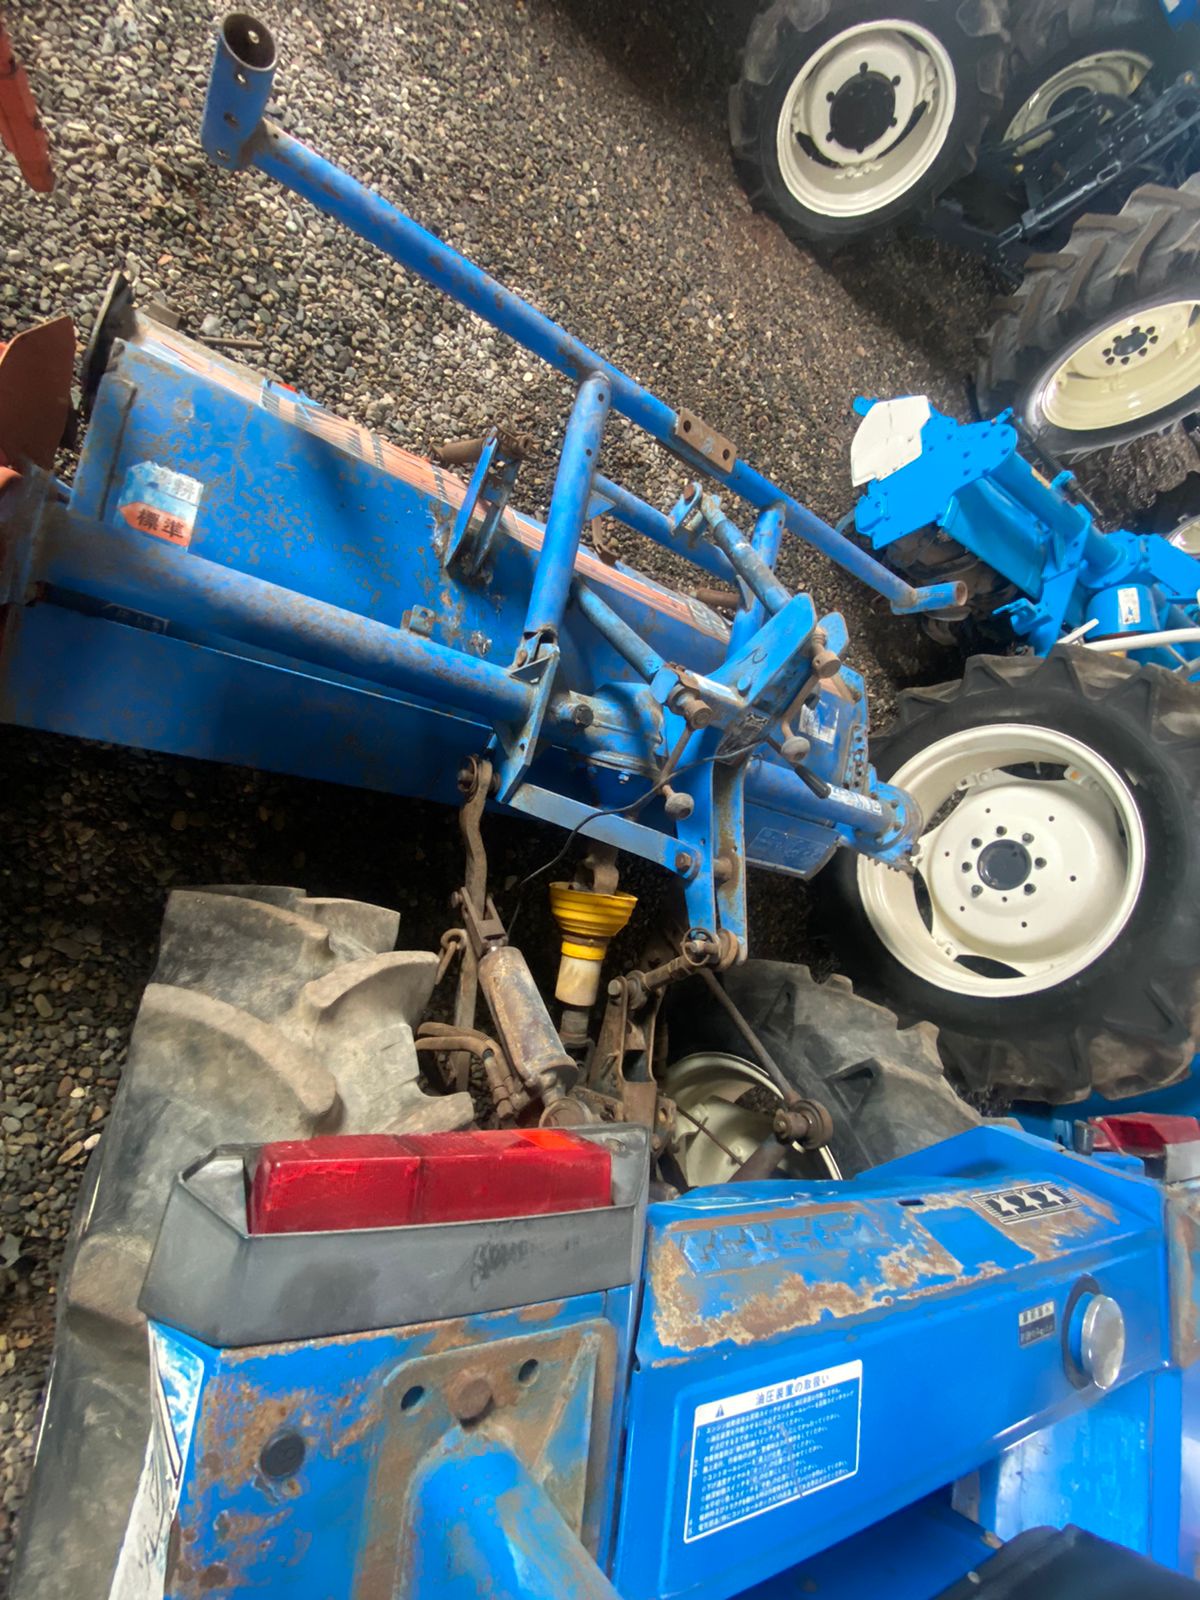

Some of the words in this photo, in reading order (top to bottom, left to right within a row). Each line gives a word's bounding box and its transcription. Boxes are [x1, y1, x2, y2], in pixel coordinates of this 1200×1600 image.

[137, 508, 184, 538] 標準
[756, 1374, 830, 1406] 油圧装置の取扱い
